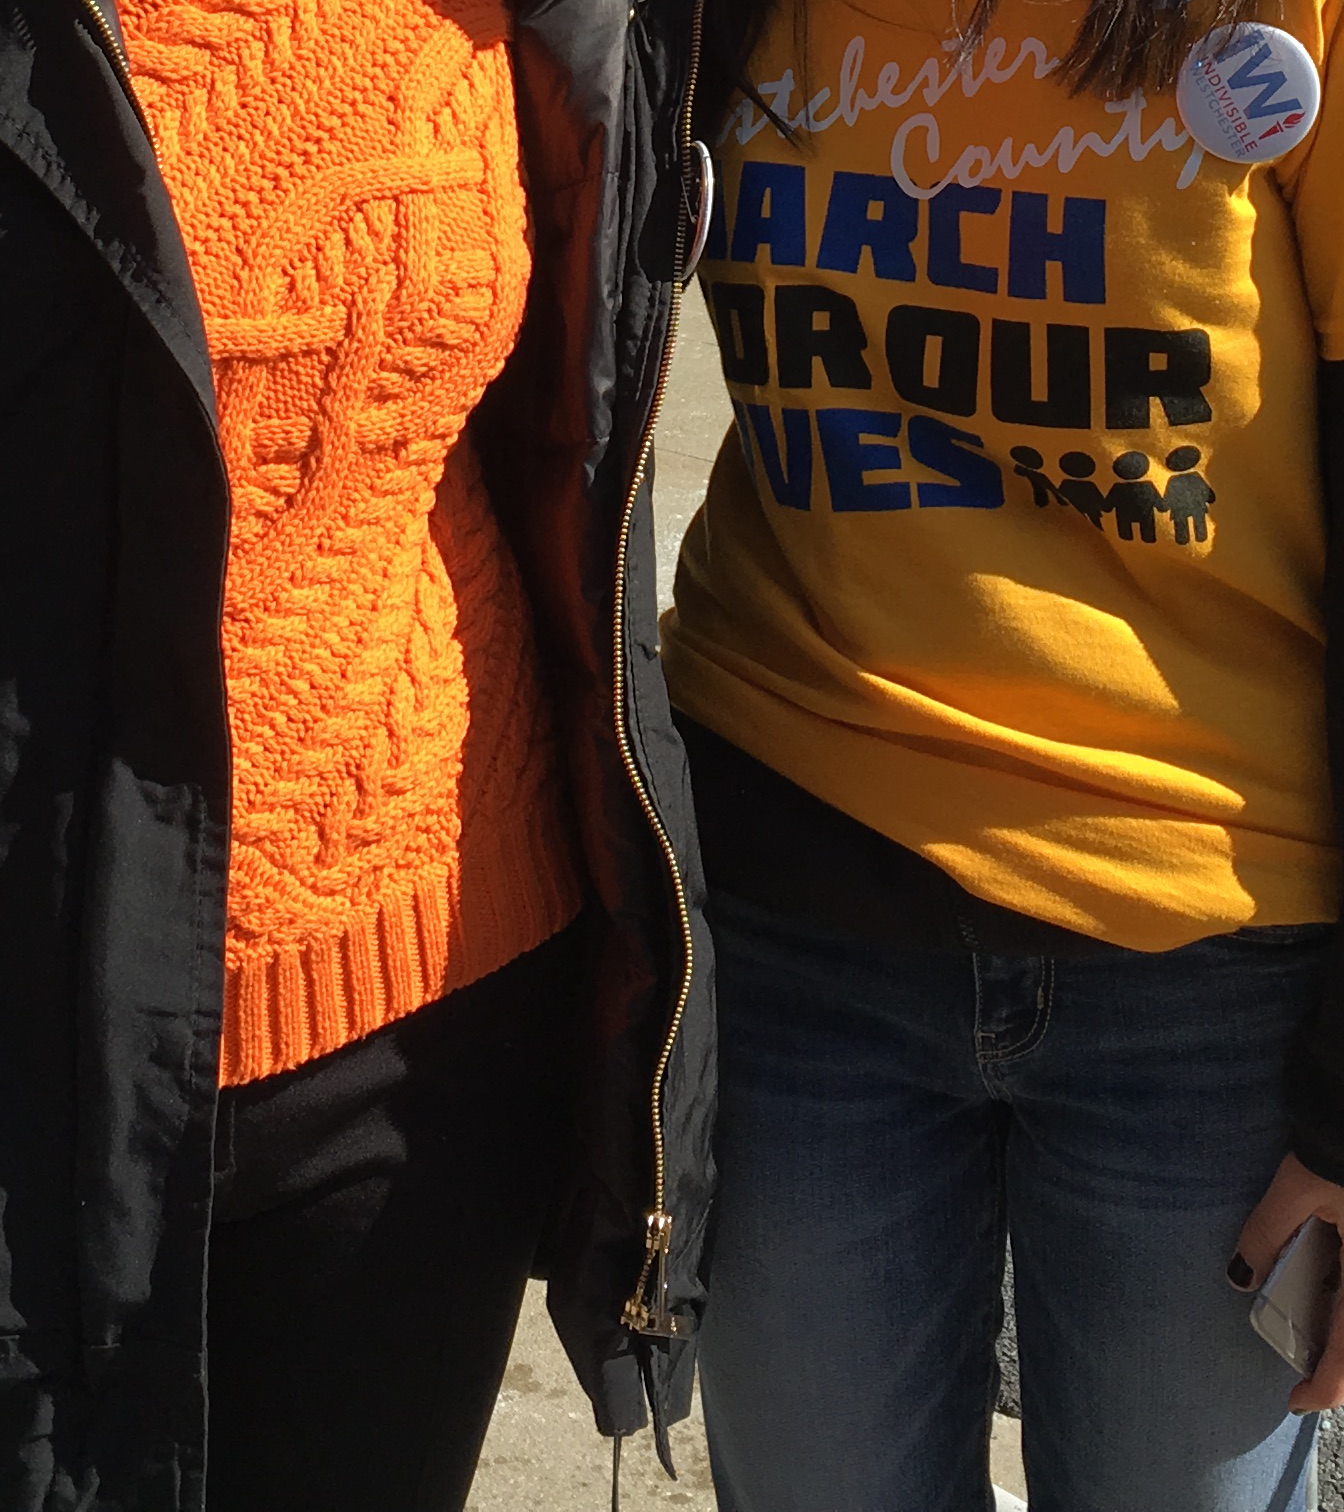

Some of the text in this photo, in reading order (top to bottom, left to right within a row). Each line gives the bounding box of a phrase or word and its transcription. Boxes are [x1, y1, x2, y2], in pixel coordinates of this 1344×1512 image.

[716, 36, 1062, 148] stchester
[1190, 66, 1247, 158] WESTCHESTER
[1199, 55, 1259, 153] INDIVISIBLE
[712, 282, 1213, 430] OR OUR
[734, 401, 1005, 513] VES
